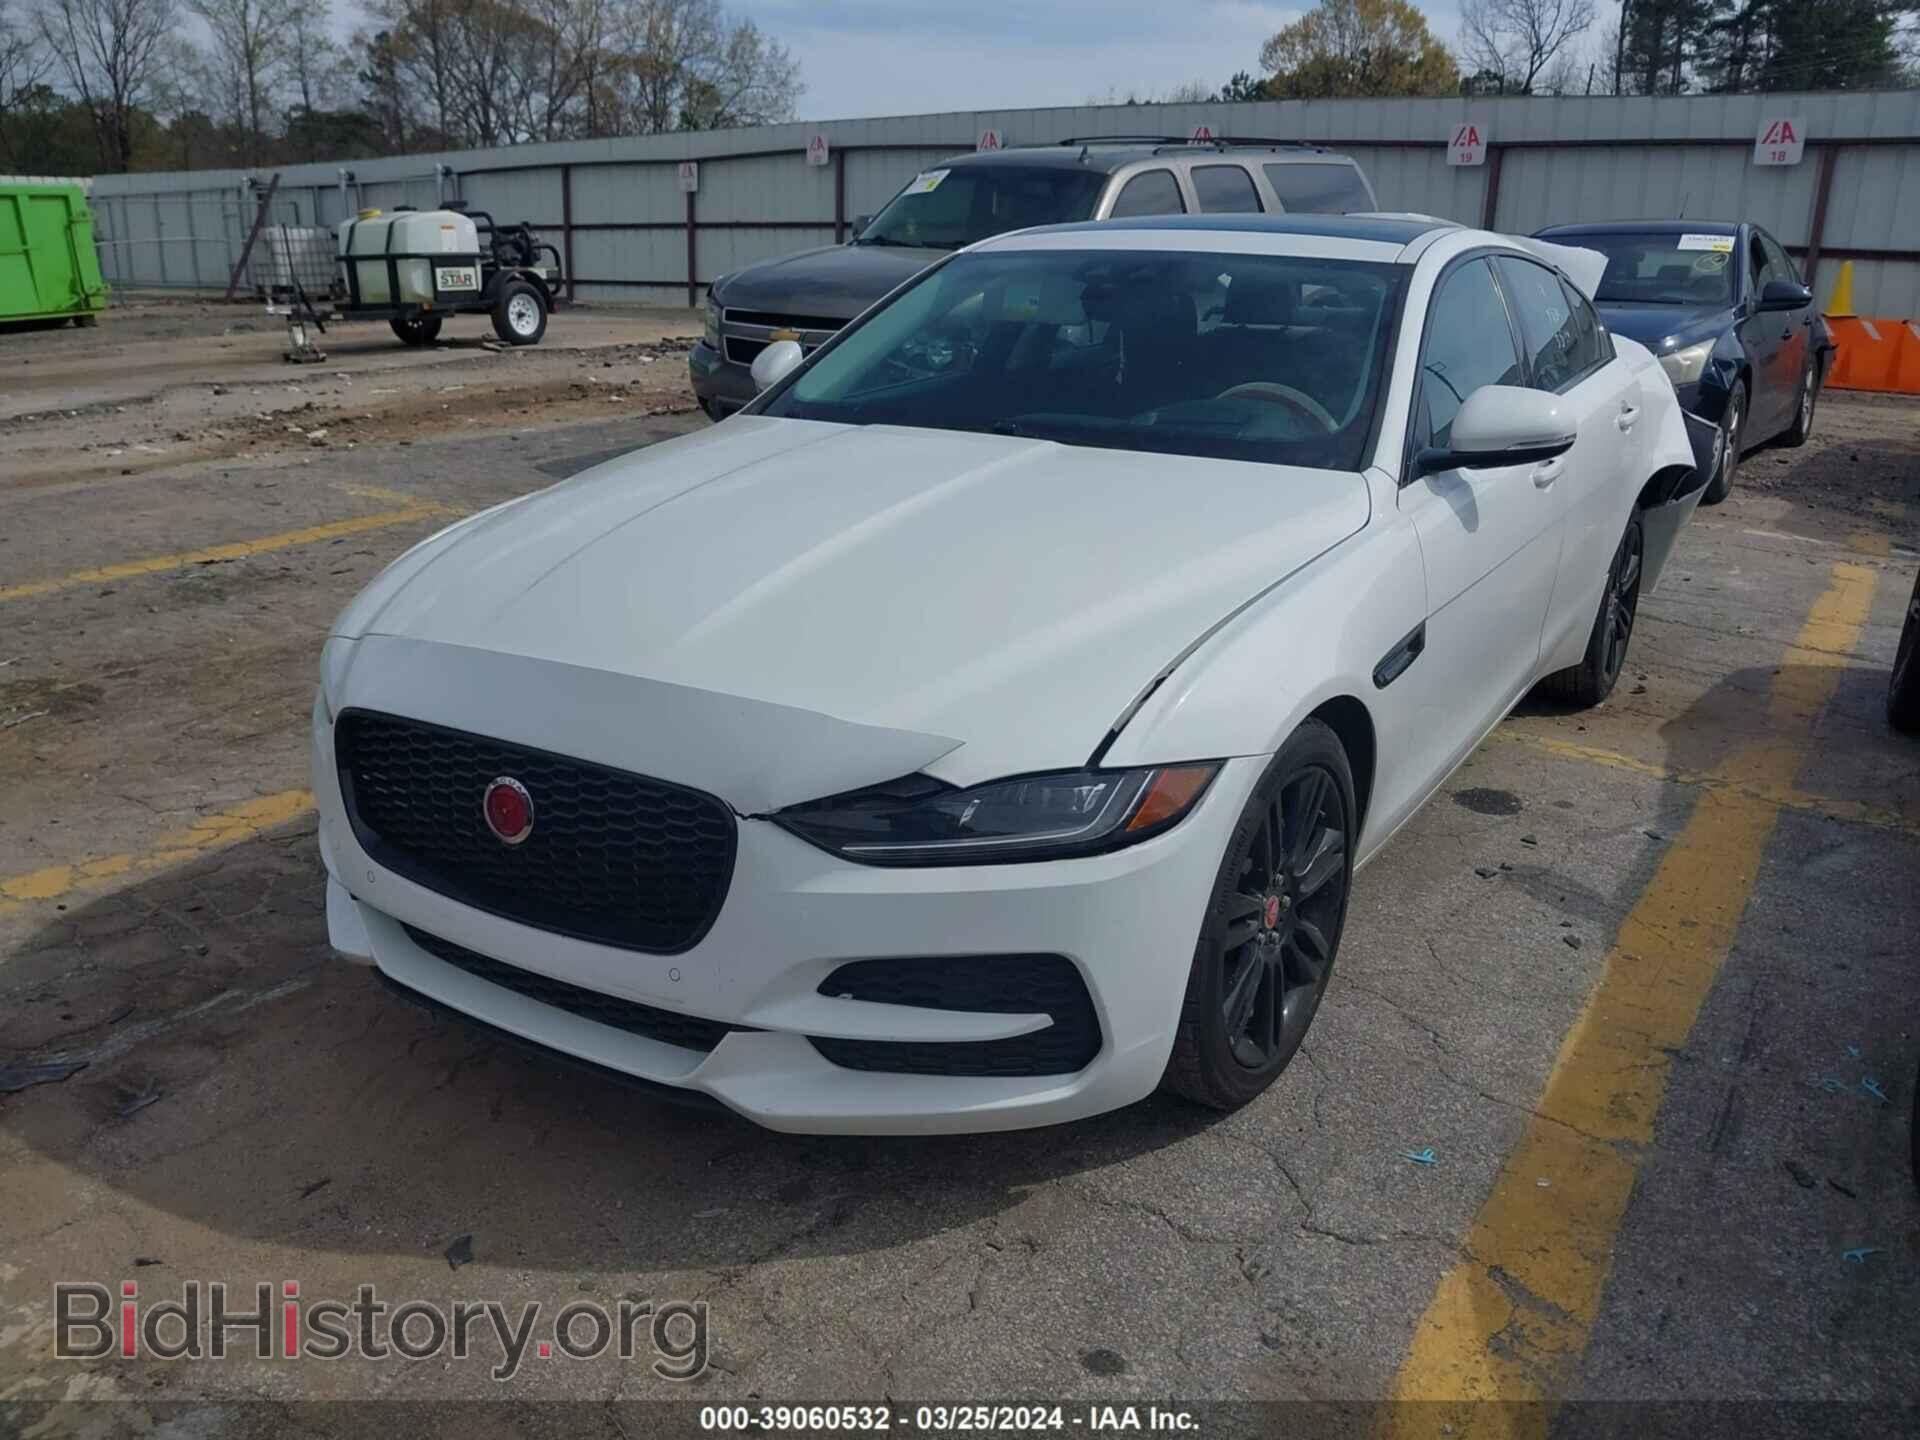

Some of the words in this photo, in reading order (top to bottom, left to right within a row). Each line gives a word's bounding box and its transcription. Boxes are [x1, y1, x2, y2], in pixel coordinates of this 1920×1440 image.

[1460, 152, 1473, 163] 19
[1770, 151, 1786, 162] 18
[440, 273, 474, 287] STAR
